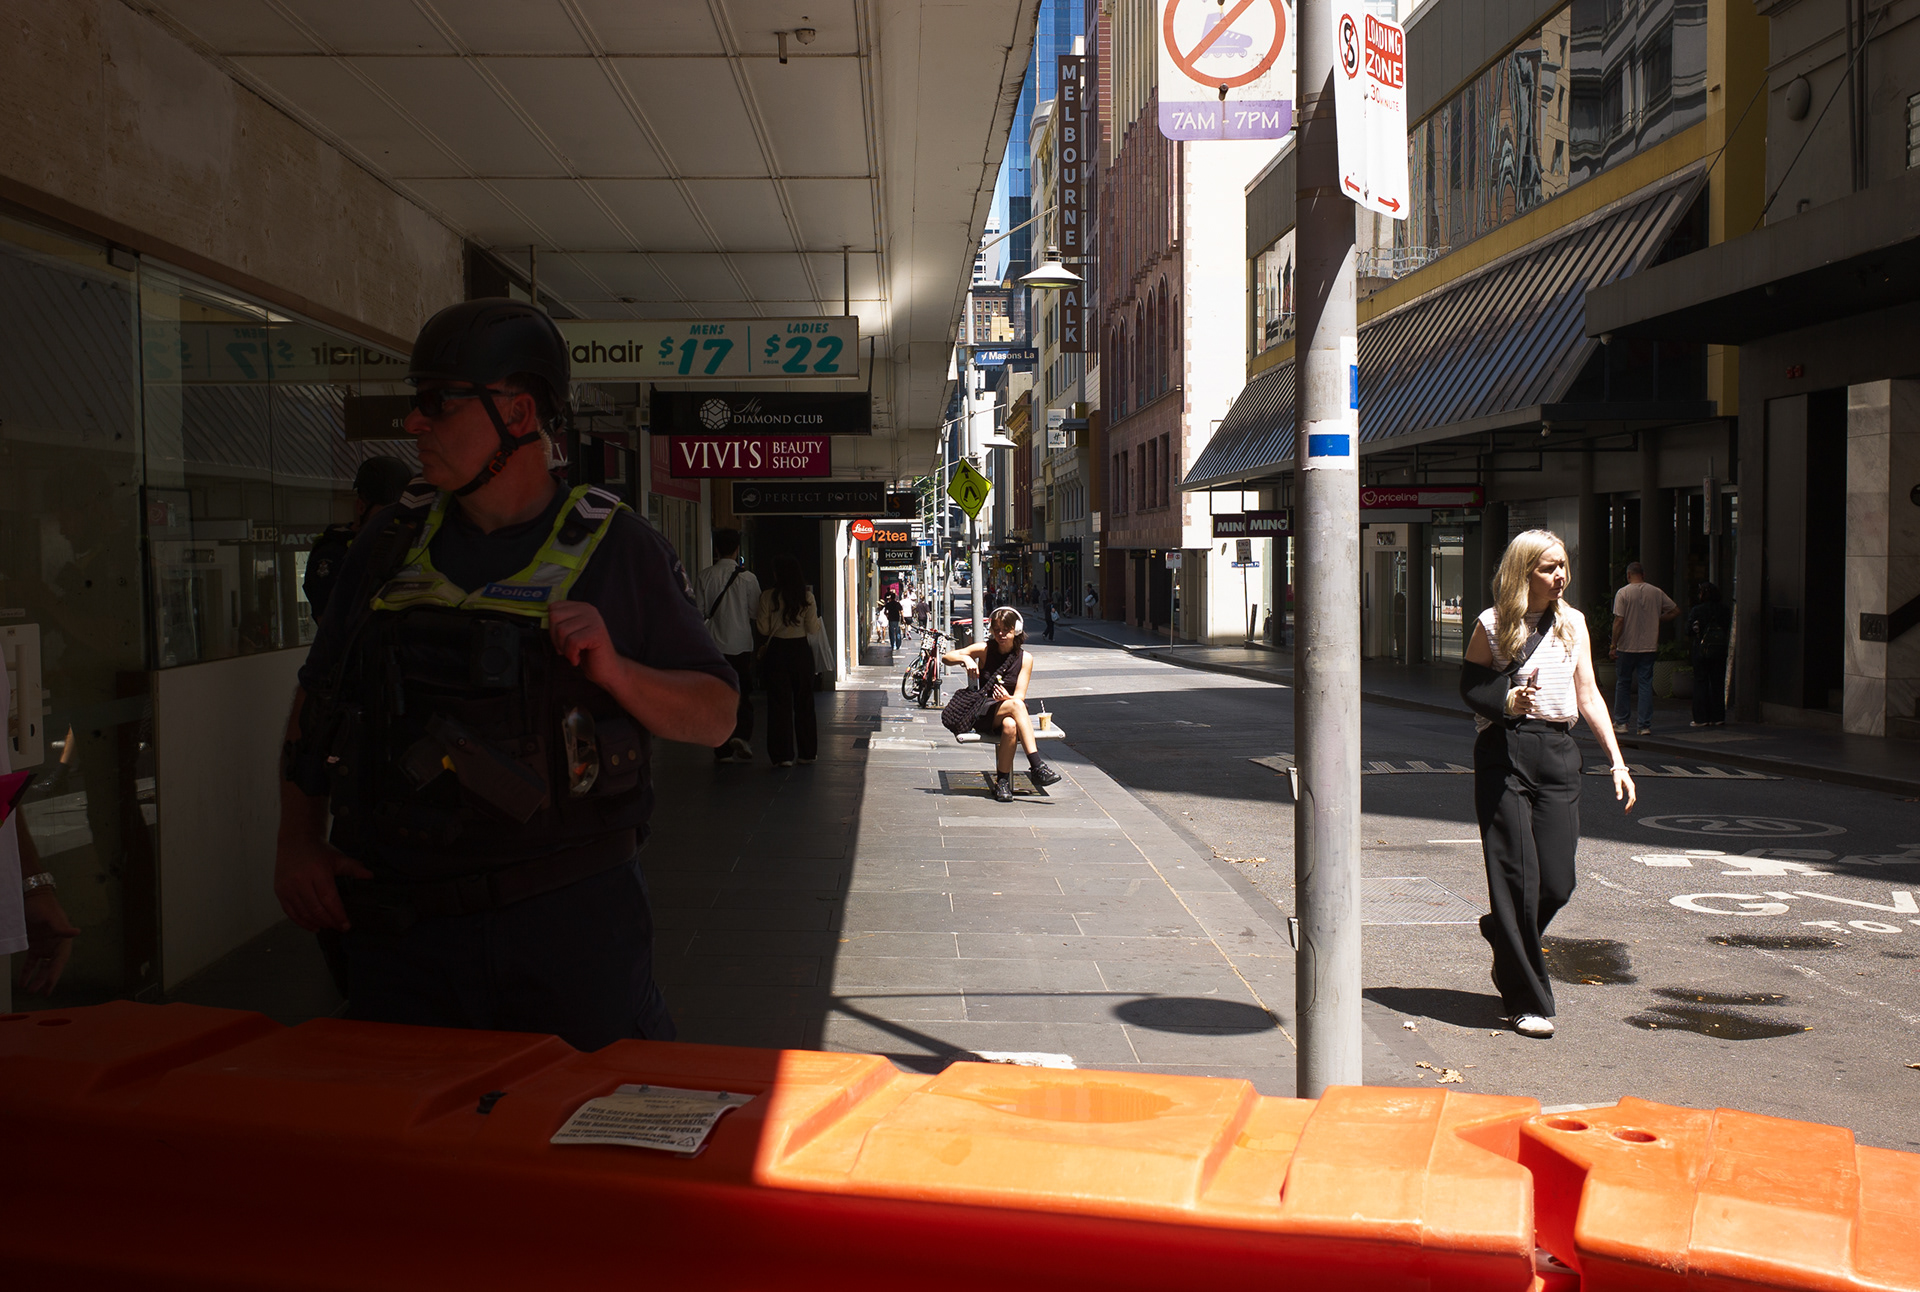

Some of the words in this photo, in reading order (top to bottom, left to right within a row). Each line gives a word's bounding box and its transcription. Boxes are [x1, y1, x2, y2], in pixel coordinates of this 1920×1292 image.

[1366, 17, 1402, 55] LOADING
[1366, 48, 1403, 86] ZONE
[1371, 84, 1381, 103] 30
[1172, 112, 1216, 129] 7AM
[1235, 111, 1280, 129] 7PM
[1062, 64, 1077, 246] MELBOURNE
[1063, 291, 1078, 343] ALK
[690, 324, 726, 336] MENS
[786, 323, 829, 334] LADIES
[988, 351, 1022, 360] Masons
[1024, 350, 1035, 359] La
[733, 396, 762, 415] My
[733, 414, 791, 425] DIAMOND
[794, 414, 824, 425] CLUB
[772, 441, 823, 454] BEAUTY
[678, 440, 762, 470] VIVI'S
[772, 456, 810, 469] SHOP
[765, 492, 822, 503] PERFECT
[827, 492, 878, 503] POTION
[1379, 493, 1418, 503] priceline
[852, 524, 873, 534] Leica
[1217, 521, 1246, 532] MIN
[490, 586, 543, 599] Police
[1676, 818, 1802, 832] 20
[1669, 891, 1920, 916] GIV
